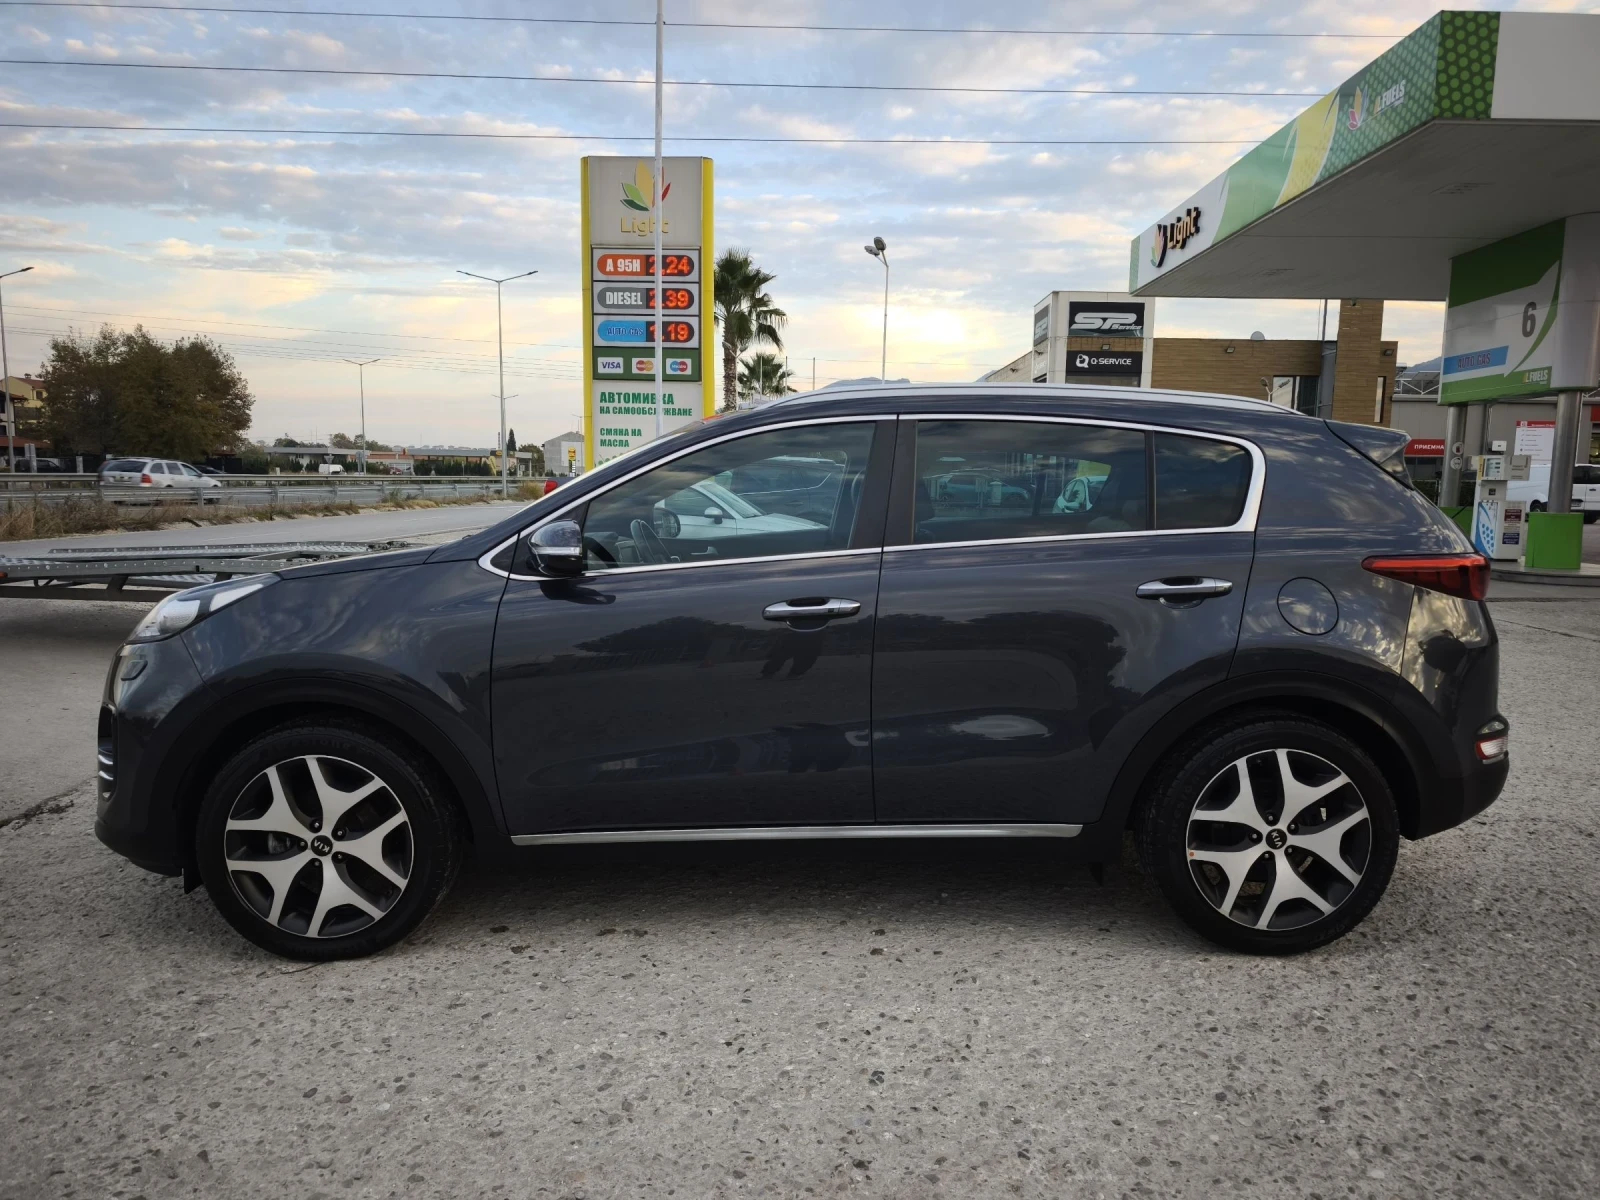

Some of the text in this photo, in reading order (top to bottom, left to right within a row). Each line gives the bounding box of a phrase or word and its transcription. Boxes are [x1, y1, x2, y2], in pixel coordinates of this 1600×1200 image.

[1167, 207, 1200, 250] Light
[606, 259, 614, 272] A
[617, 258, 640, 272] 95H
[606, 291, 642, 305] DIESEL
[1521, 301, 1537, 338] 6
[601, 361, 621, 369] VISA
[1457, 352, 1491, 369] AUTO GAS
[600, 406, 611, 415] НА
[600, 427, 642, 437] СМЯНА НА
[600, 439, 630, 448] МАСЛА
[313, 839, 330, 854] KIA
[1270, 830, 1283, 849] KIA
